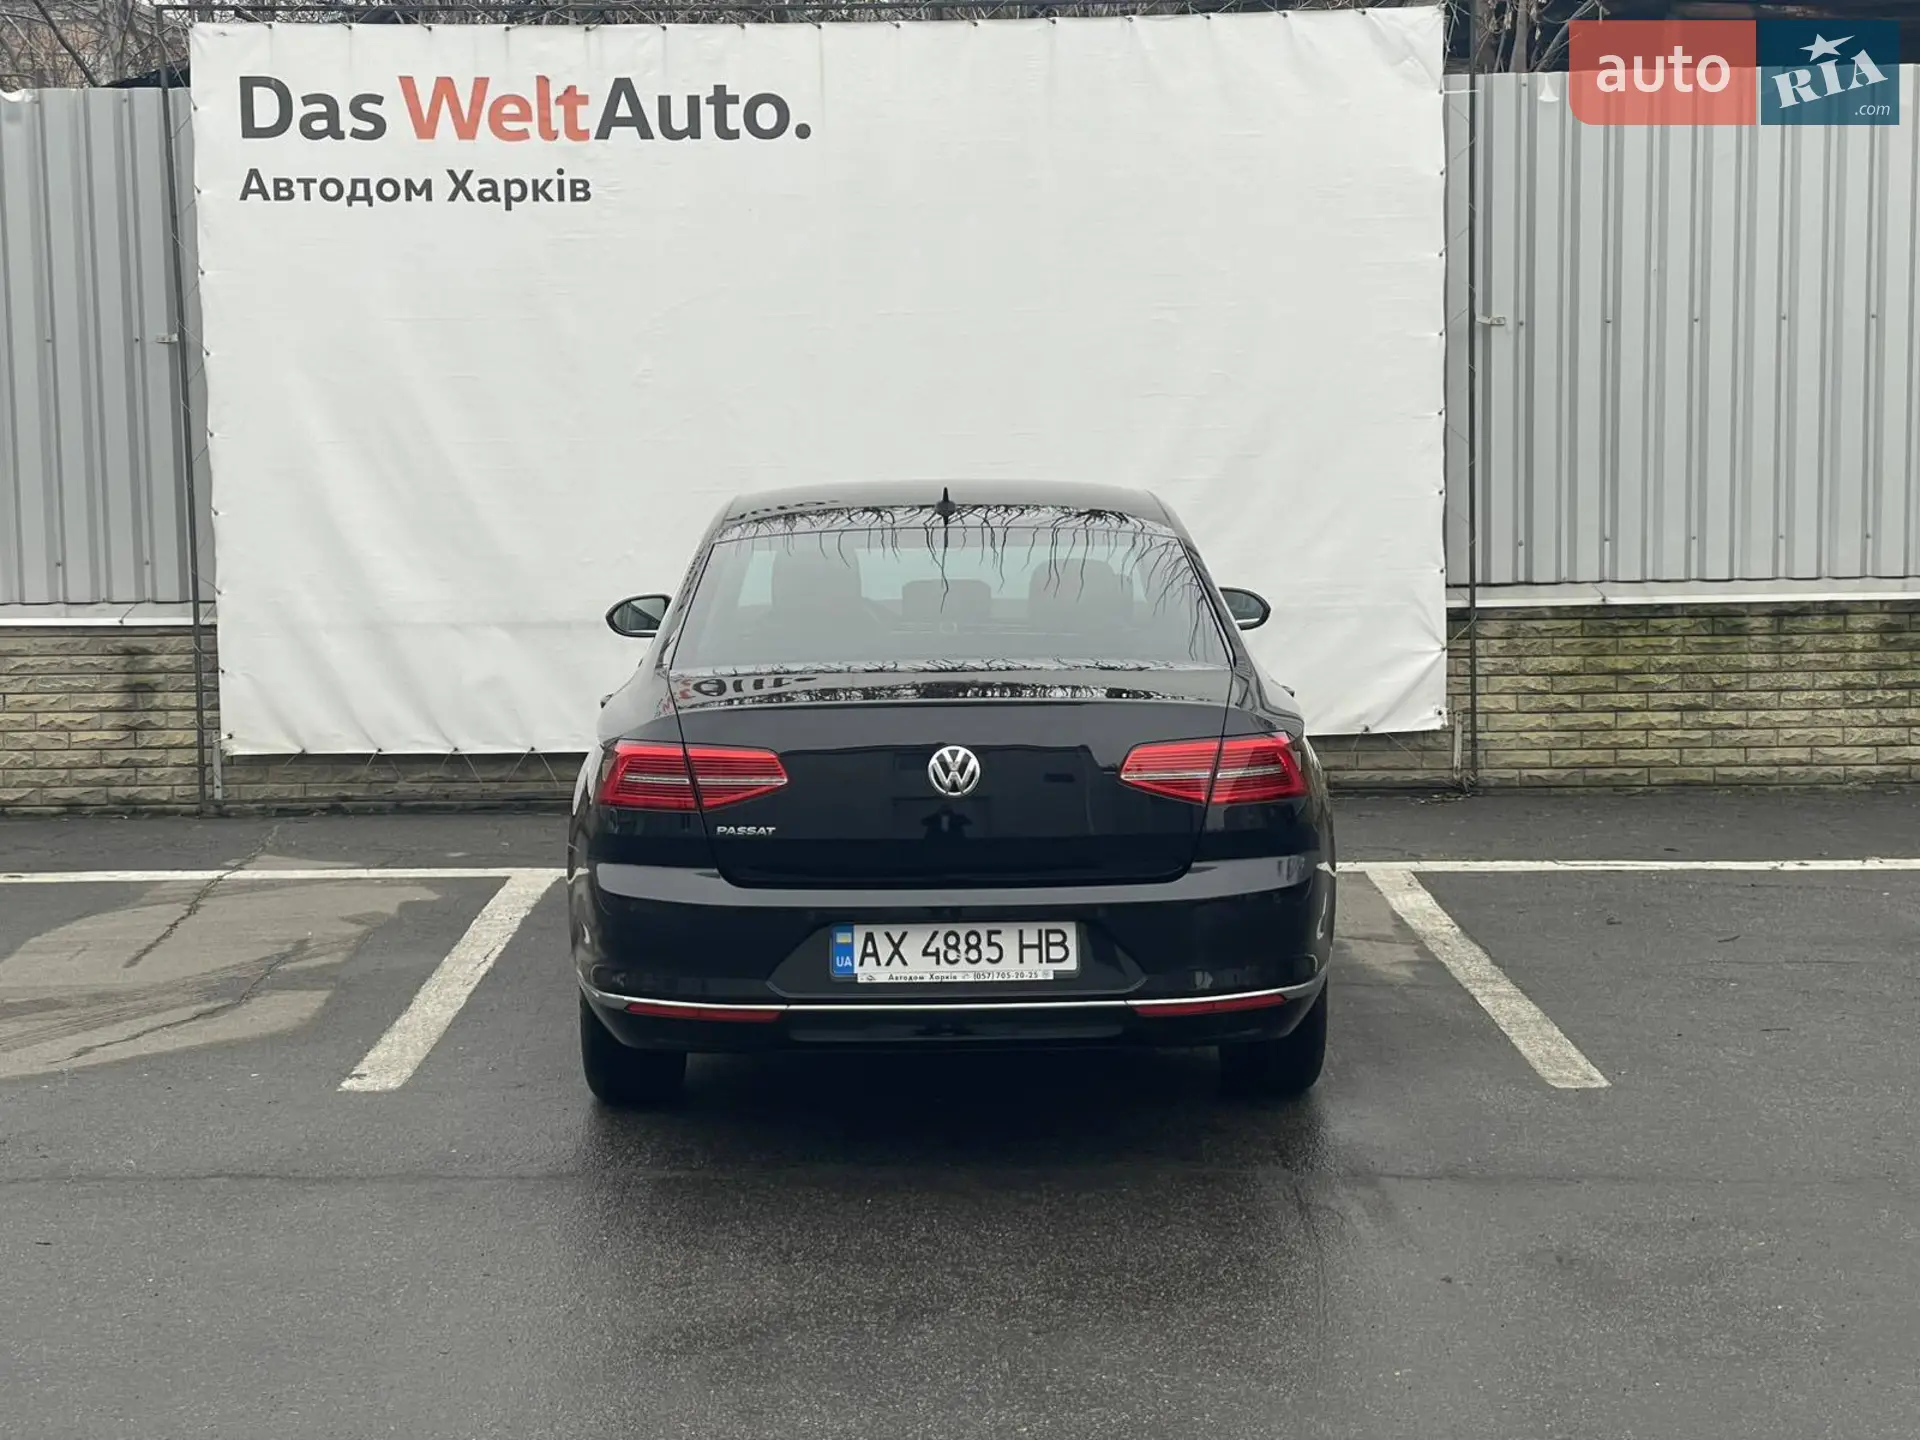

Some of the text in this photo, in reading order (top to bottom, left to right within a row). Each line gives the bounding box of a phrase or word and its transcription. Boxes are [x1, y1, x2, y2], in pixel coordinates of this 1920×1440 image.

[239, 75, 812, 142] Das WeltAuto.
[239, 167, 592, 211] Автодом Харків
[716, 825, 776, 836] PASSAT
[835, 955, 852, 967] UA
[858, 928, 1070, 967] AX 4885 HB
